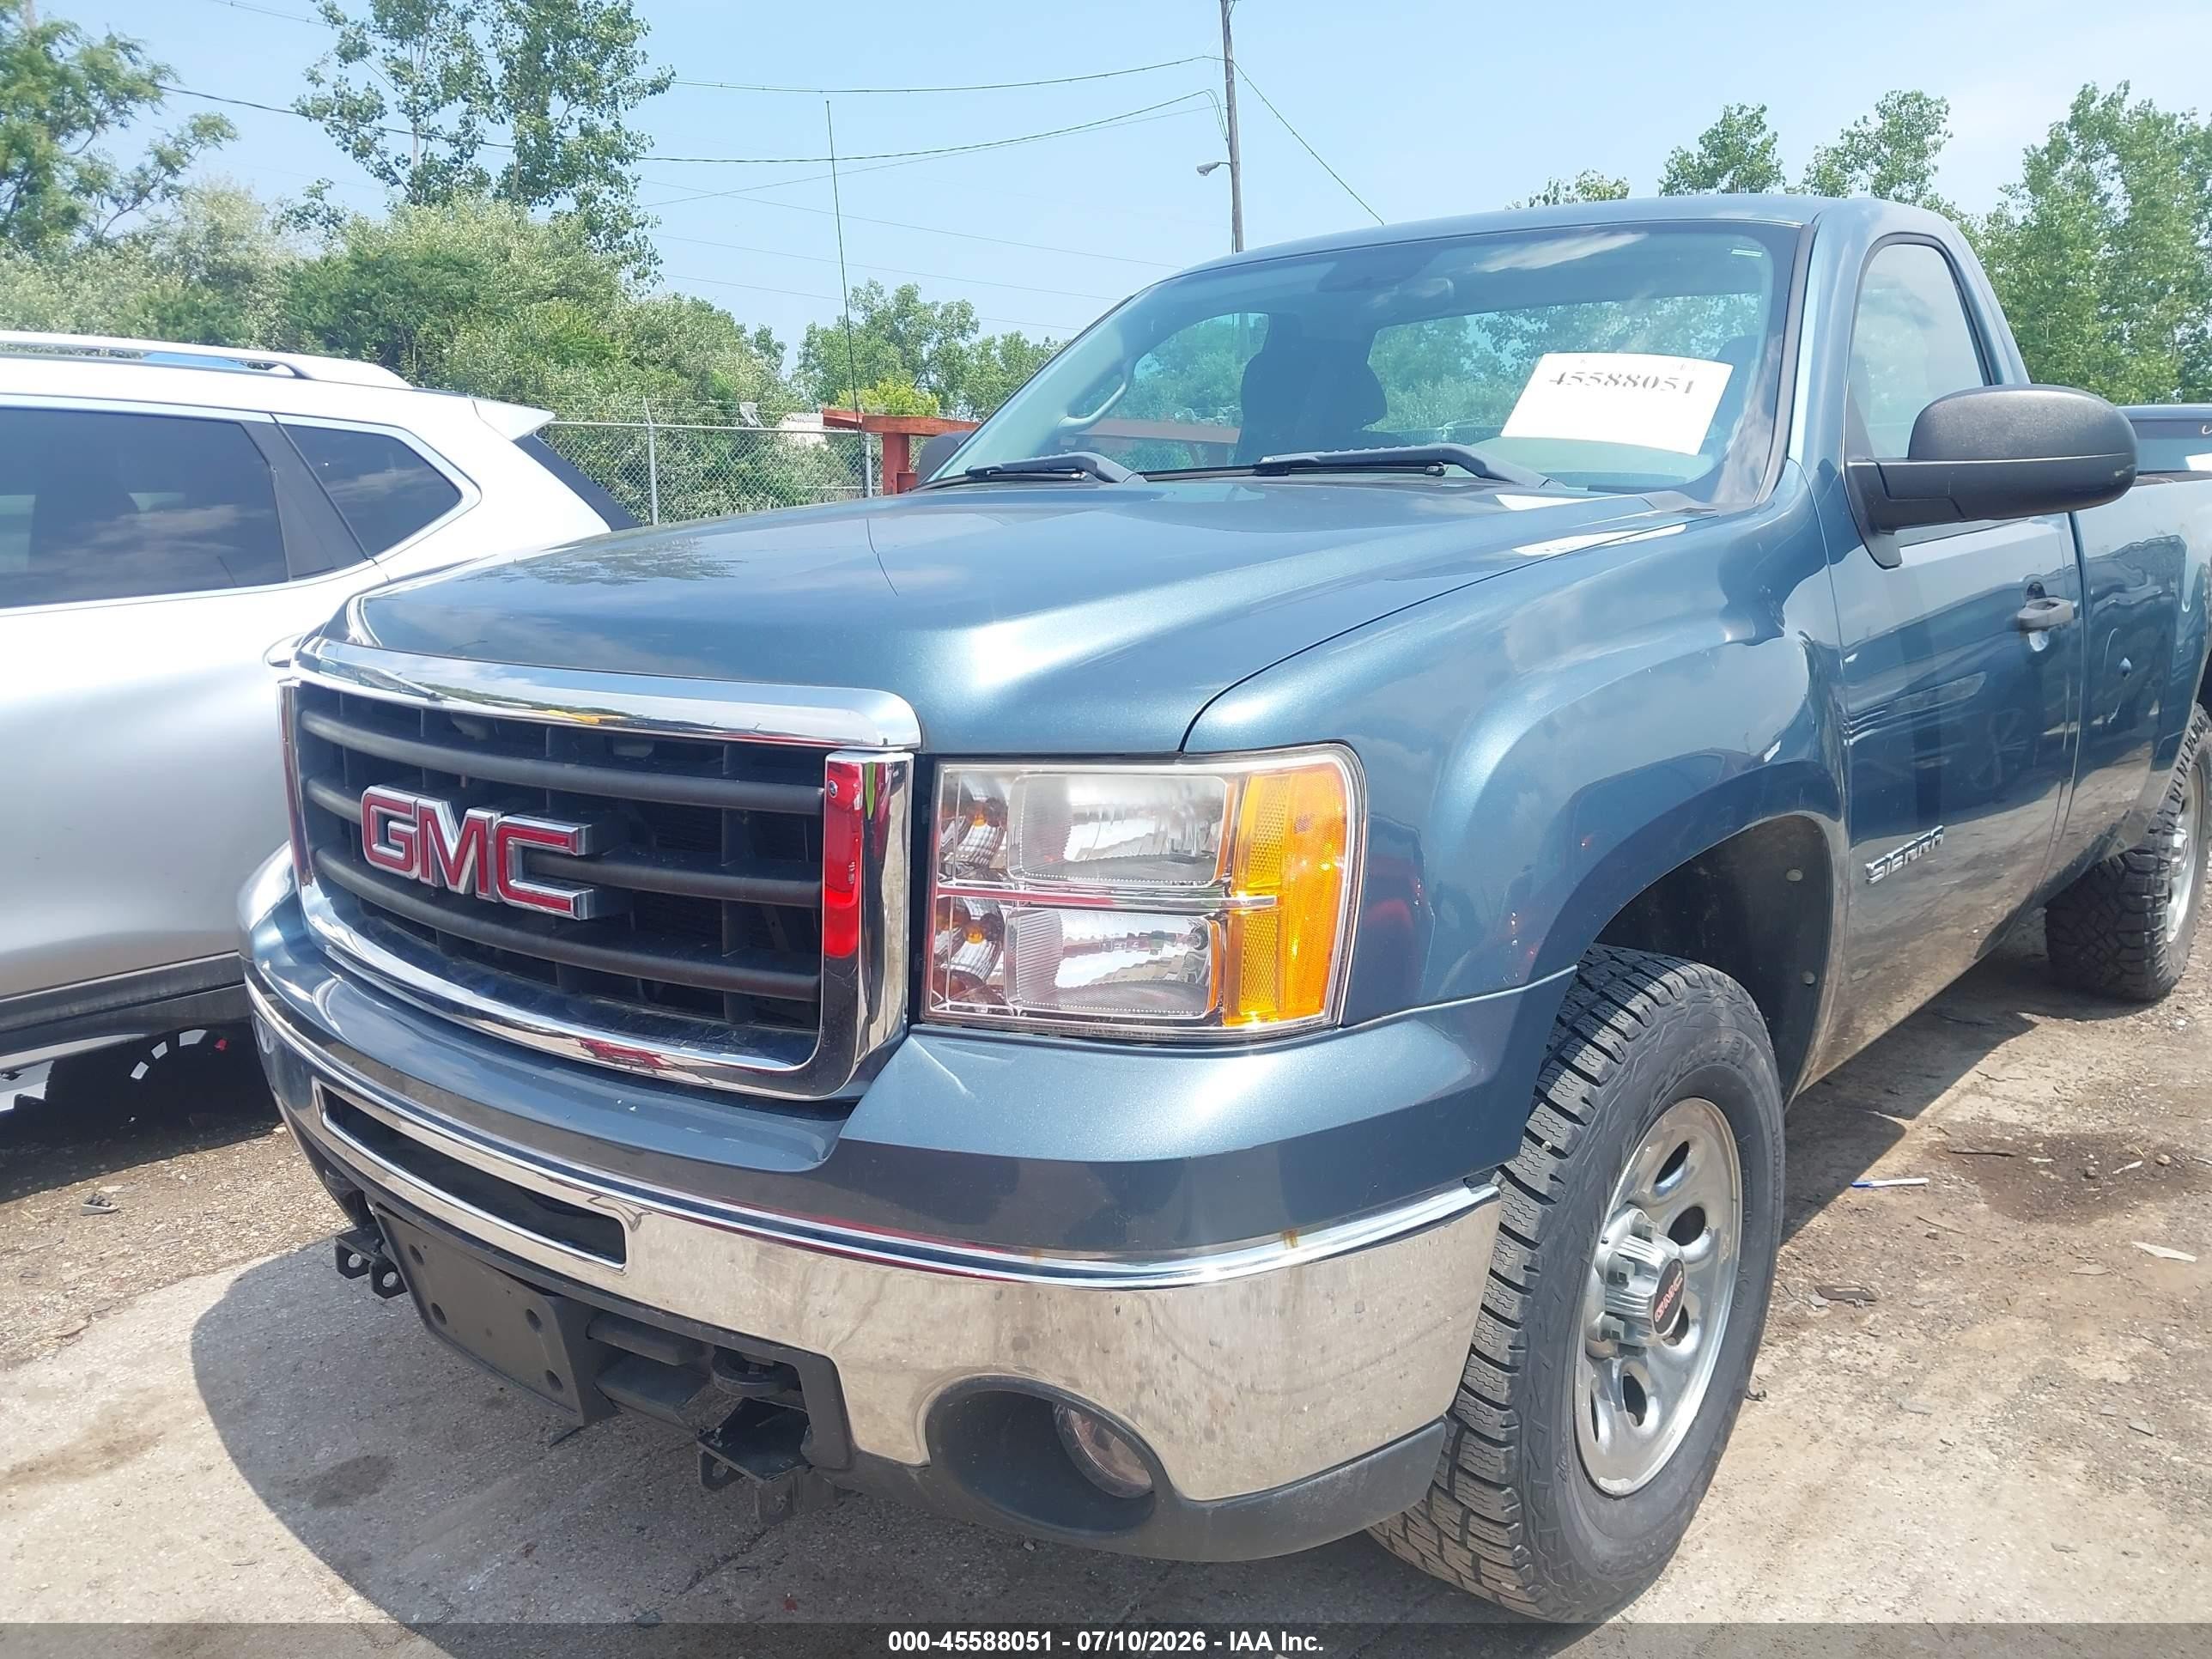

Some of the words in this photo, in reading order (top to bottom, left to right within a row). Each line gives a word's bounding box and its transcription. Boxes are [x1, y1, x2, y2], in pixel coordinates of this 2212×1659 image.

[1548, 370, 1695, 394] 45588051
[361, 784, 594, 921] GMC
[1864, 824, 1944, 885] SIERRA
[1654, 1270, 1684, 1322] GMC
